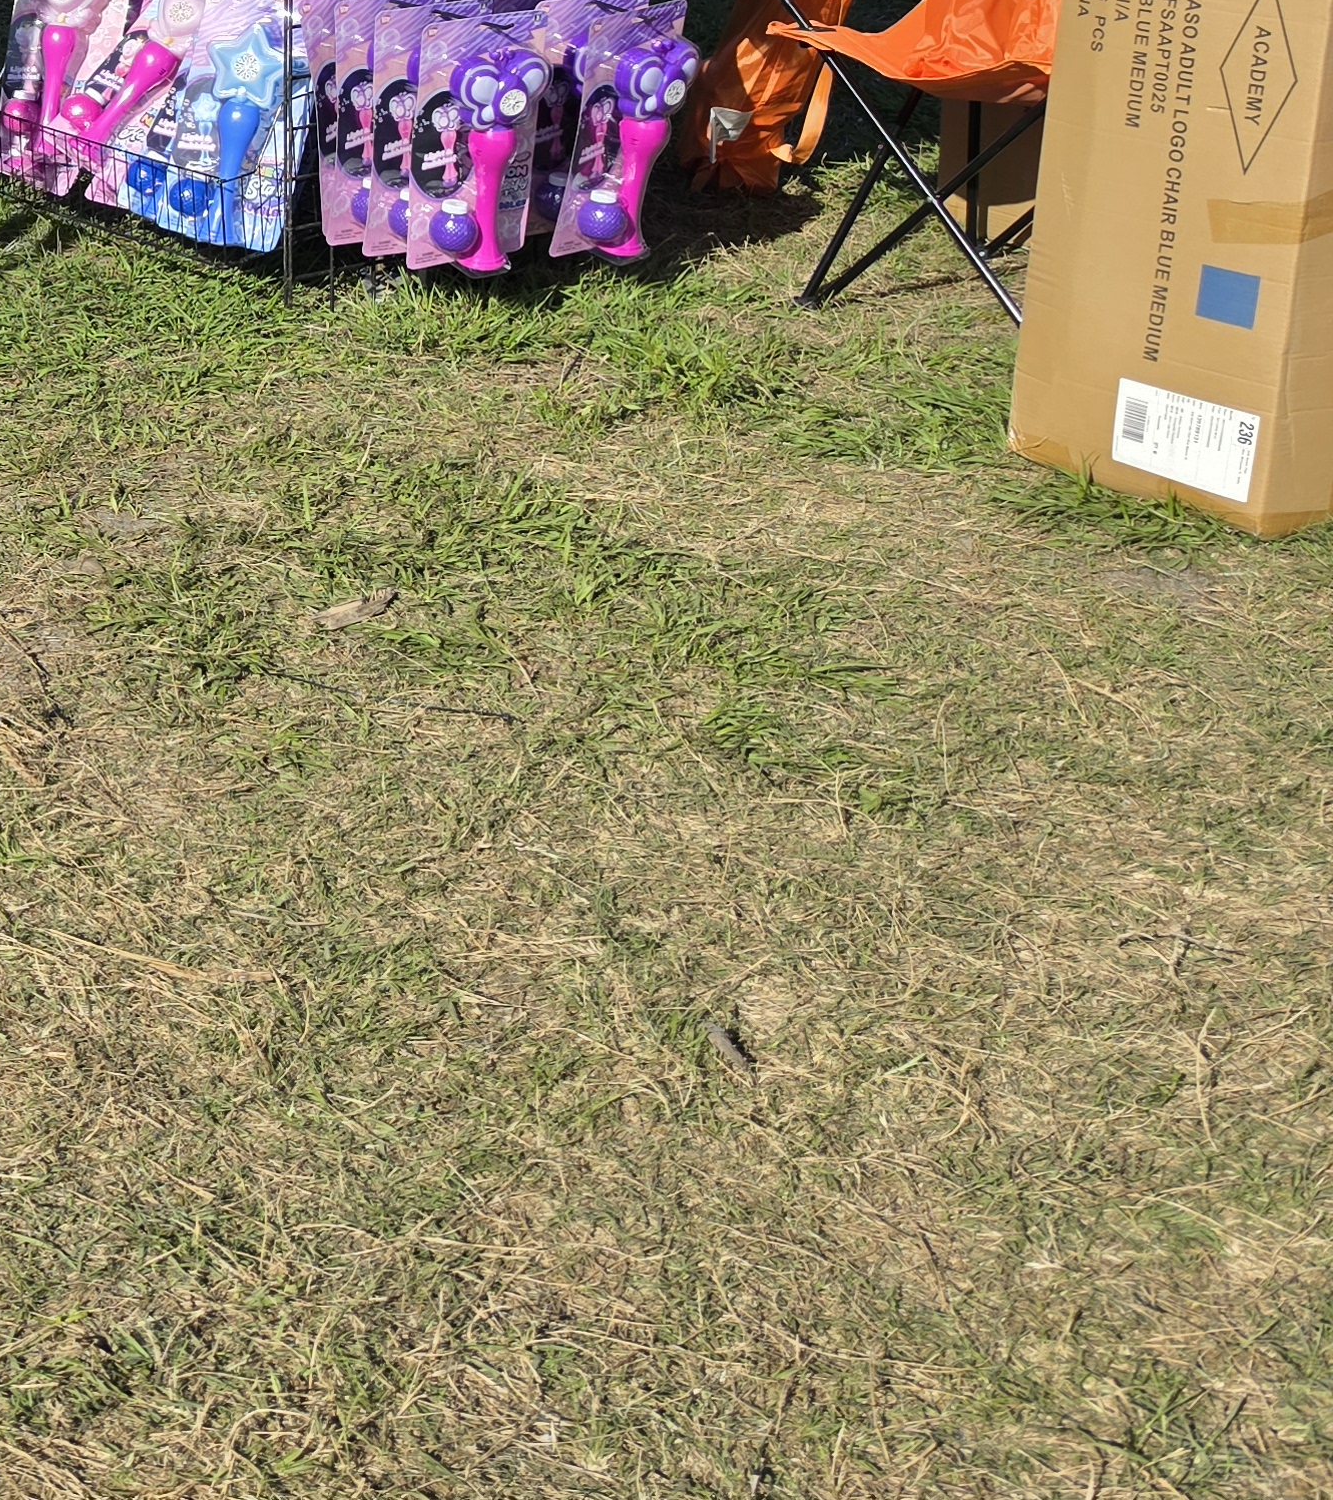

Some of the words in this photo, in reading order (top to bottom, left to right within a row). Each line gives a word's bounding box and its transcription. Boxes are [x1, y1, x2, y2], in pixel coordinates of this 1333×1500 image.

[1090, 15, 1107, 53] PCS
[1125, 50, 1148, 128] MEDIUM
[1176, 42, 1196, 106] ADULT
[1244, 25, 1272, 127] ACADEMY
[1168, 108, 1190, 164] LOGO
[508, 165, 528, 178] ON
[1161, 166, 1183, 225] CHAIR
[1155, 229, 1175, 282] BLUE
[1142, 284, 1167, 363] MEDIUM
[1237, 421, 1255, 446] 236
